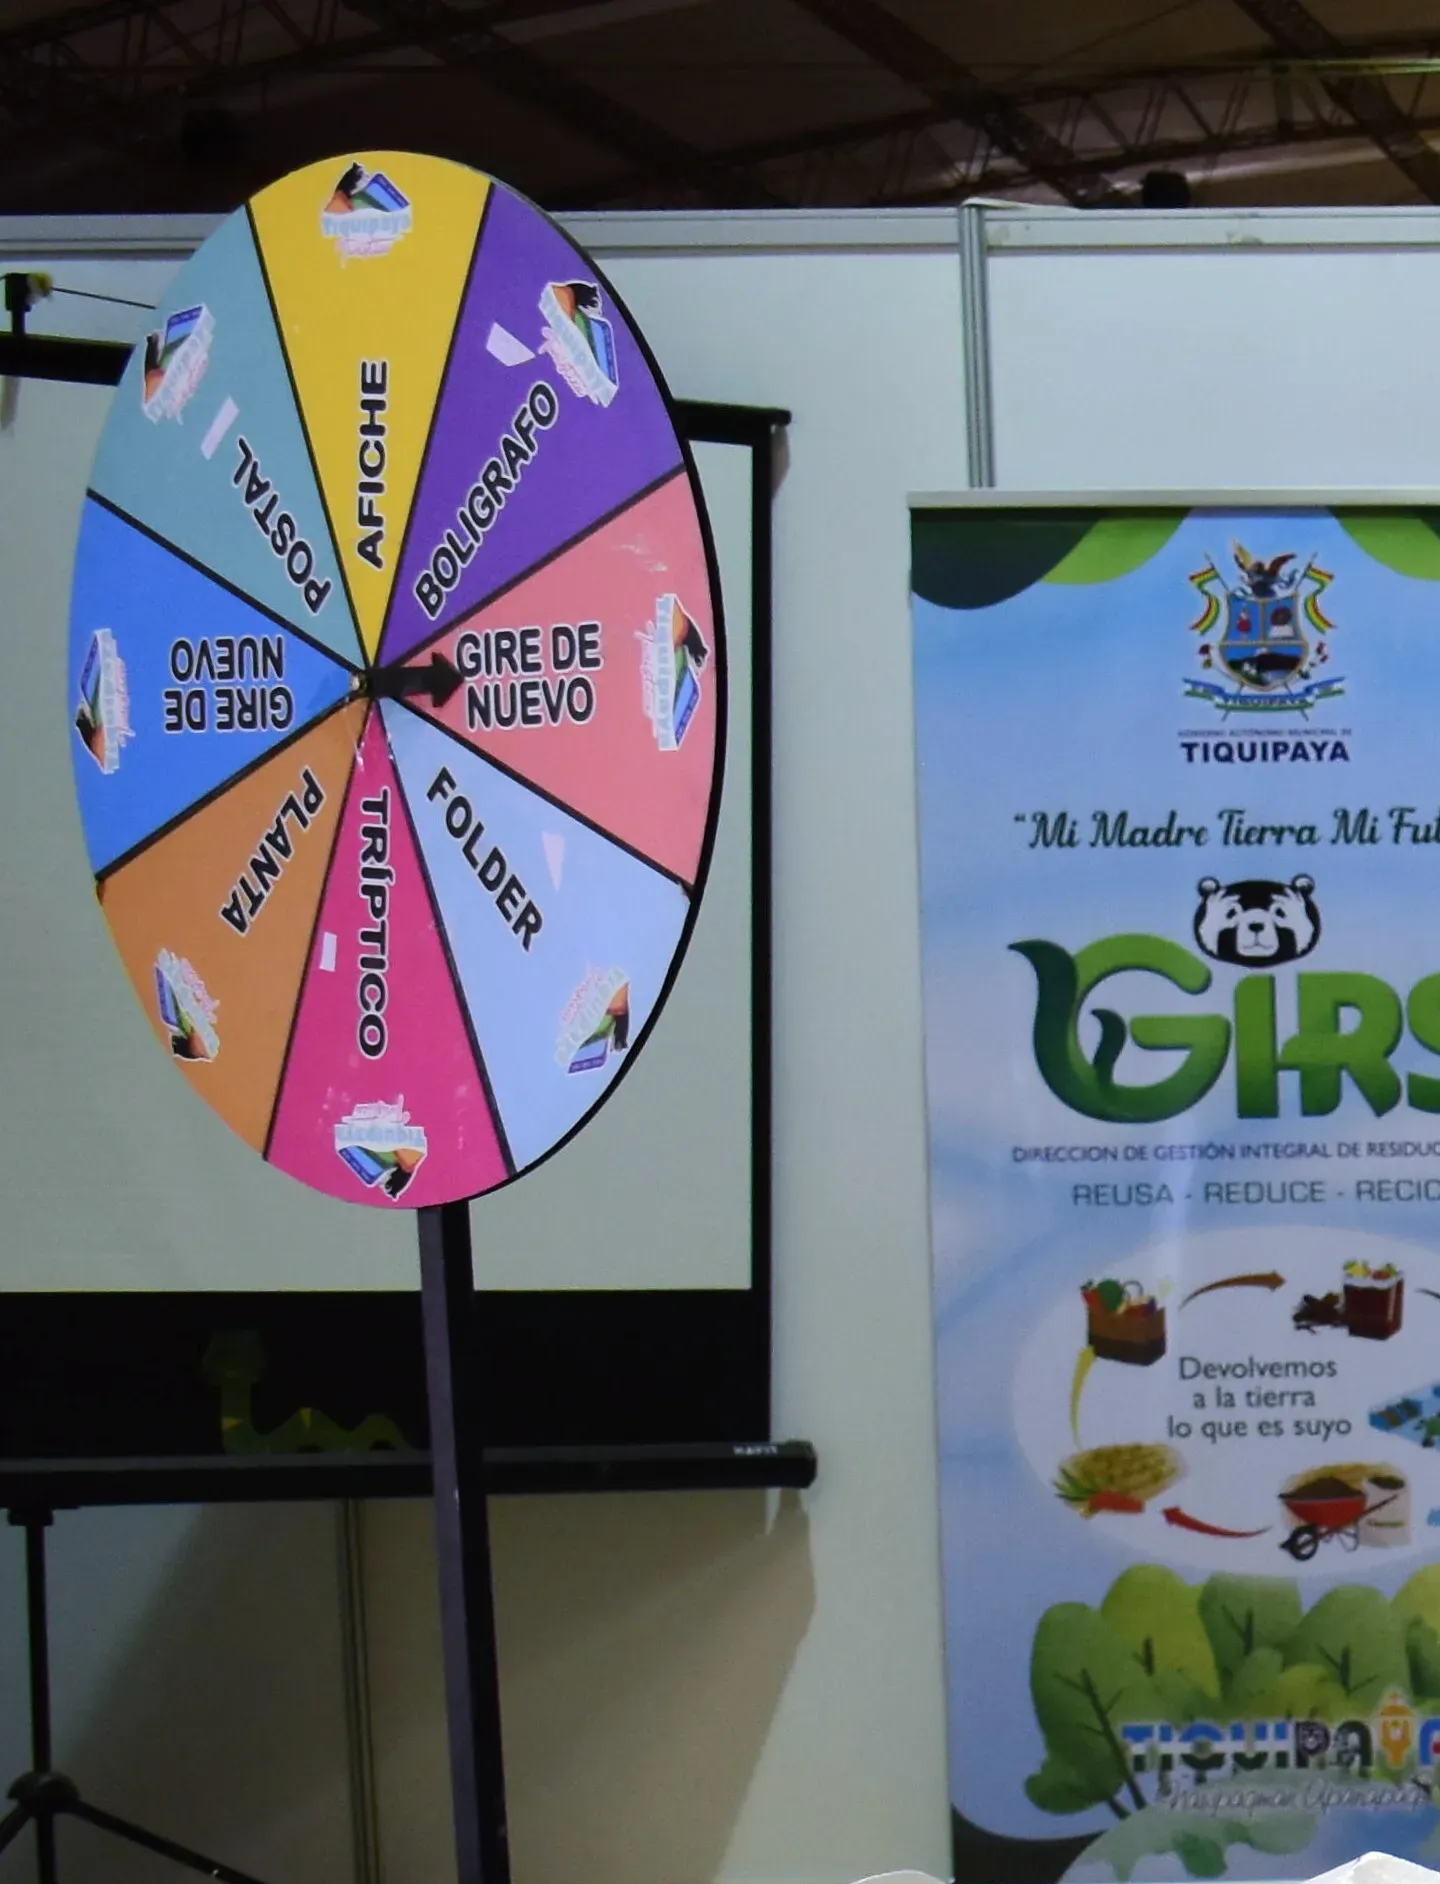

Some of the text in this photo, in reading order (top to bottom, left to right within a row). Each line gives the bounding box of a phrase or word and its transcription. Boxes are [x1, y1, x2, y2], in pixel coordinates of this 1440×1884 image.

[355, 359, 389, 570] AFICHE
[412, 380, 558, 621] BOLIGRAFO
[230, 435, 332, 615] POSTAL
[170, 636, 285, 682] NUEVO
[455, 621, 601, 680] GIRE DE
[164, 688, 294, 734] GIRE DE
[466, 676, 595, 731] NUEVO
[1180, 740, 1350, 764] TIQUIPAYA
[1090, 810, 1209, 850] Madre
[1218, 807, 1320, 848] Tierra
[1330, 809, 1380, 847] Mi
[219, 768, 326, 938] PLANTA
[426, 766, 544, 952] FOLDER
[356, 789, 391, 1060] TRÍPTICO
[1011, 1145, 1119, 1165] DIRECCION
[1122, 1144, 1150, 1162] DE
[1154, 1139, 1236, 1162] GESTIÓN
[1240, 1142, 1334, 1160] INTEGRAL
[1338, 1141, 1361, 1160] DE
[1072, 1182, 1174, 1207] REUSA
[1204, 1181, 1325, 1206] REDUCE
[1178, 1355, 1338, 1381] Devolvemos
[1192, 1385, 1316, 1409] a la tierra
[1167, 1415, 1352, 1444] lo que es suyo
